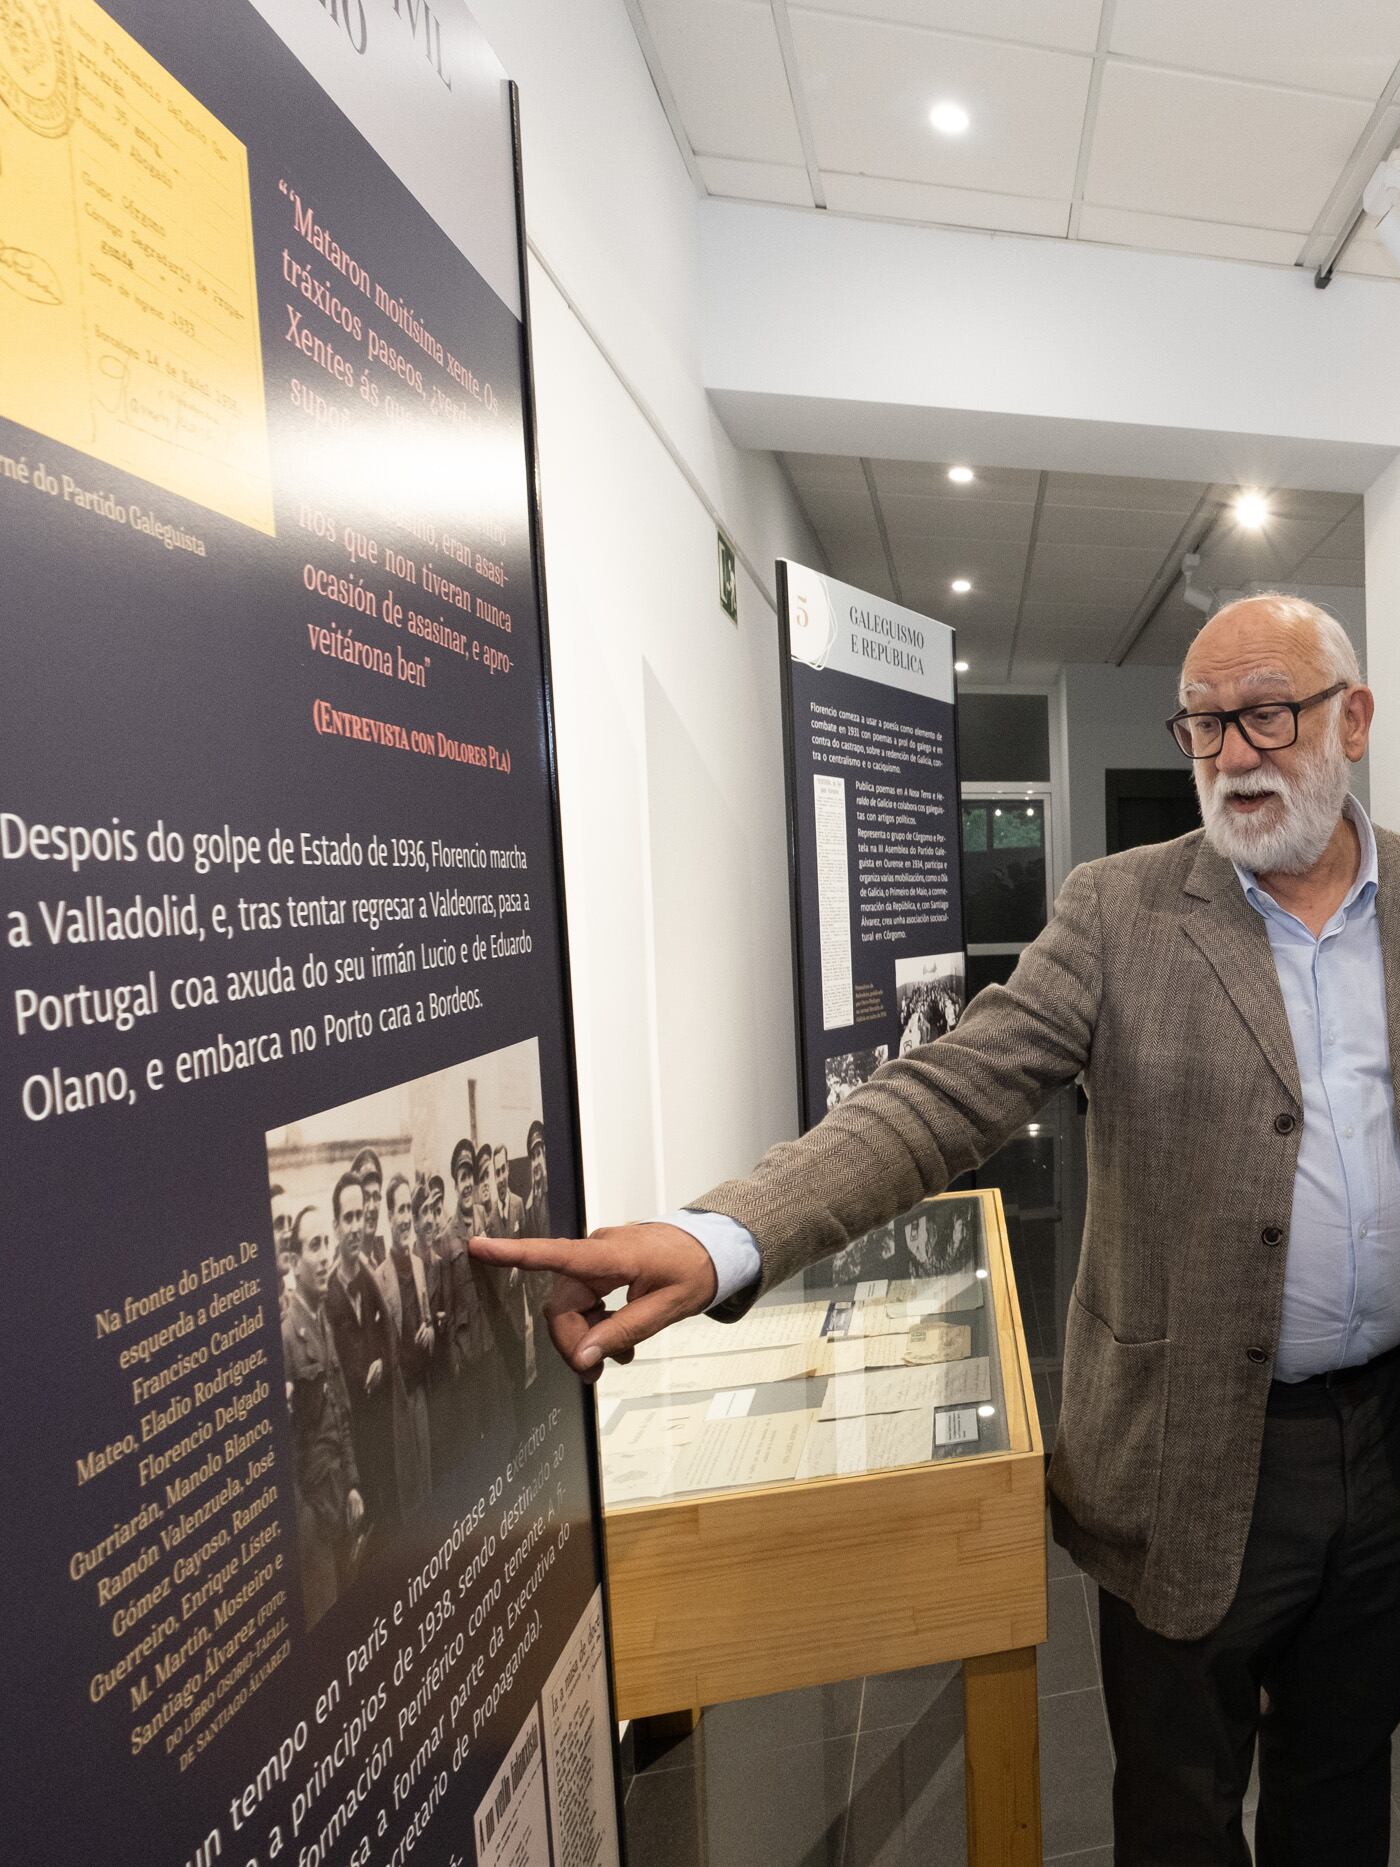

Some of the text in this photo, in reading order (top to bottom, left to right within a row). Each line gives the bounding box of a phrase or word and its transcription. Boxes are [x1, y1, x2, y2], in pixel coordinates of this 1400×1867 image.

[282, 249, 362, 341] tráxicos
[368, 328, 426, 399] paseos,
[285, 304, 354, 388] Xentes
[360, 369, 379, 407] ás
[375, 283, 444, 366] moitísima
[33, 463, 57, 496] do
[61, 474, 126, 524] Partido
[129, 505, 206, 557] Galeguista
[442, 534, 509, 588] eran asasi-
[303, 564, 515, 675] ocasión de asasinar, apro-
[344, 526, 378, 563] que
[385, 547, 416, 585] non
[422, 563, 471, 612] tiveran
[476, 598, 512, 633] nunca
[797, 595, 809, 628] 5
[850, 605, 925, 650] GALEGUISMO
[308, 622, 393, 677] veitárona
[851, 634, 924, 675] E REPÚBLICA
[437, 732, 487, 768] DOLORES
[810, 702, 860, 723] Florencio comeza
[811, 720, 837, 733] combate
[811, 736, 831, 748] contra
[0, 813, 527, 874] Despois do golpe de Estado de 1936, Florencio marcha
[7, 888, 530, 948] a Valladolid, e, tras tentar regresar a Valdeorras, pasa a
[14, 929, 532, 1036] Portugal coa axuda do seu irmán Lucio e de Eduardo
[22, 985, 483, 1122] Olano, e embarca no Porto cara a Bordeos.
[95, 1241, 258, 1340] Na fronte do Ebro. De
[119, 1279, 261, 1370] esquerda a dereita:
[132, 1305, 264, 1406] Francisco Caridad
[75, 1348, 268, 1487] Mateo, Eladio Rodríguez,
[139, 1381, 269, 1487] Florencio Delgado
[70, 1418, 273, 1582] Gurriarán, Manolo Blanco,
[97, 1445, 276, 1607] Ramón Valenzuela, José
[90, 1518, 282, 1703] Guerreiro, Enrique Líster,
[112, 1484, 278, 1638] Gómez Gayoso, Ramón
[156, 1562, 273, 1685] Martín, Mosteiro
[229, 1476, 503, 1831] tempo en París e incorpórase ao
[393, 1522, 570, 1810] formar parte da Executiva do
[398, 1516, 546, 1741] Periférico como tenente.
[473, 1608, 543, 1739] Propaganda).
[130, 1617, 257, 1755] Santiago Álvarez
[292, 1535, 496, 1838] principios de 1938, sendo
